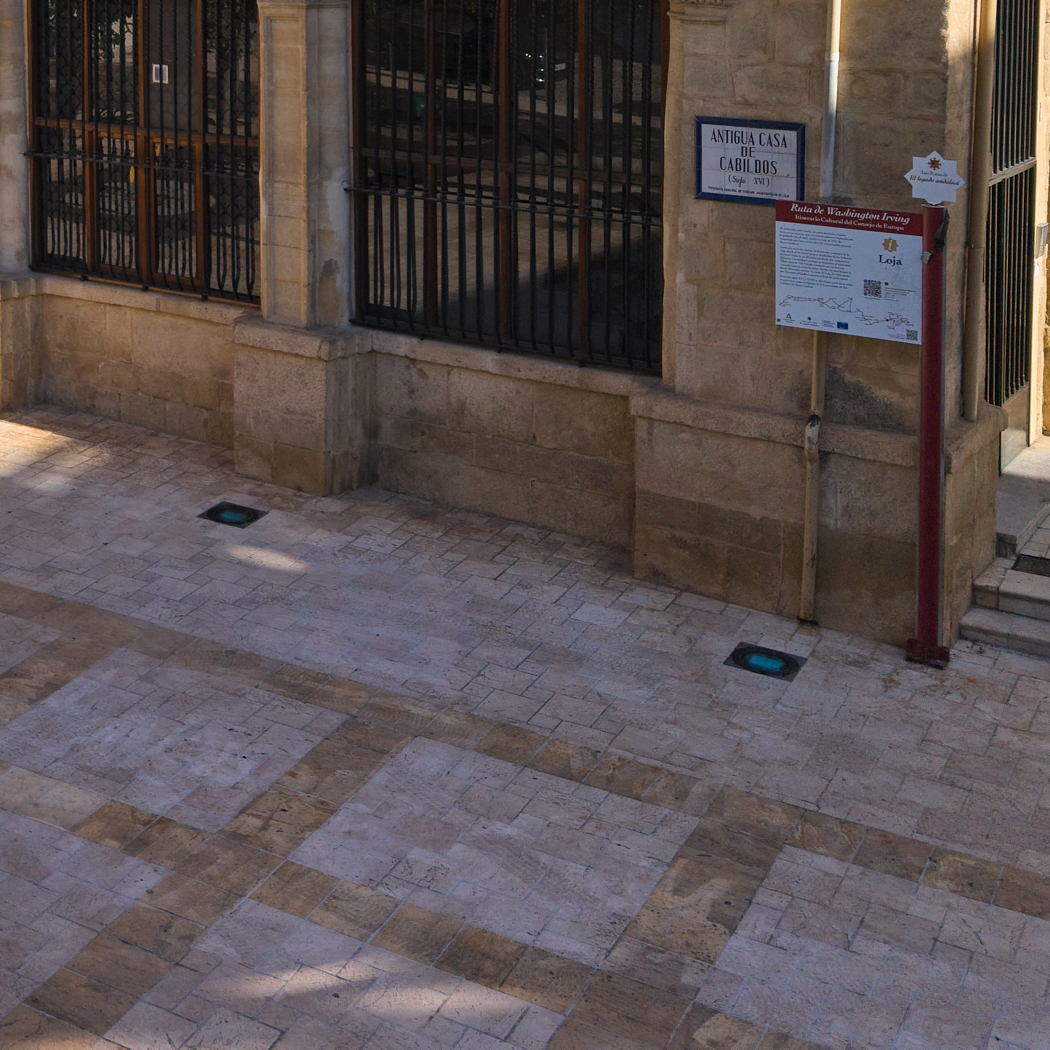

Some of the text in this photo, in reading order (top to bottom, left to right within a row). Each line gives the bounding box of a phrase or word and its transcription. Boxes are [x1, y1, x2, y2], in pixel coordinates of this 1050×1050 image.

[711, 129, 787, 148] ANTIGUA CASA
[741, 146, 756, 158] DE
[720, 157, 778, 175] CABILDOS
[790, 203, 910, 225] Ruta de Washington Irving
[795, 214, 820, 222] Itinerario
[821, 217, 844, 225] Cultural
[853, 220, 875, 228] Consejo
[883, 223, 905, 231] Europa
[879, 255, 902, 266] Loja
